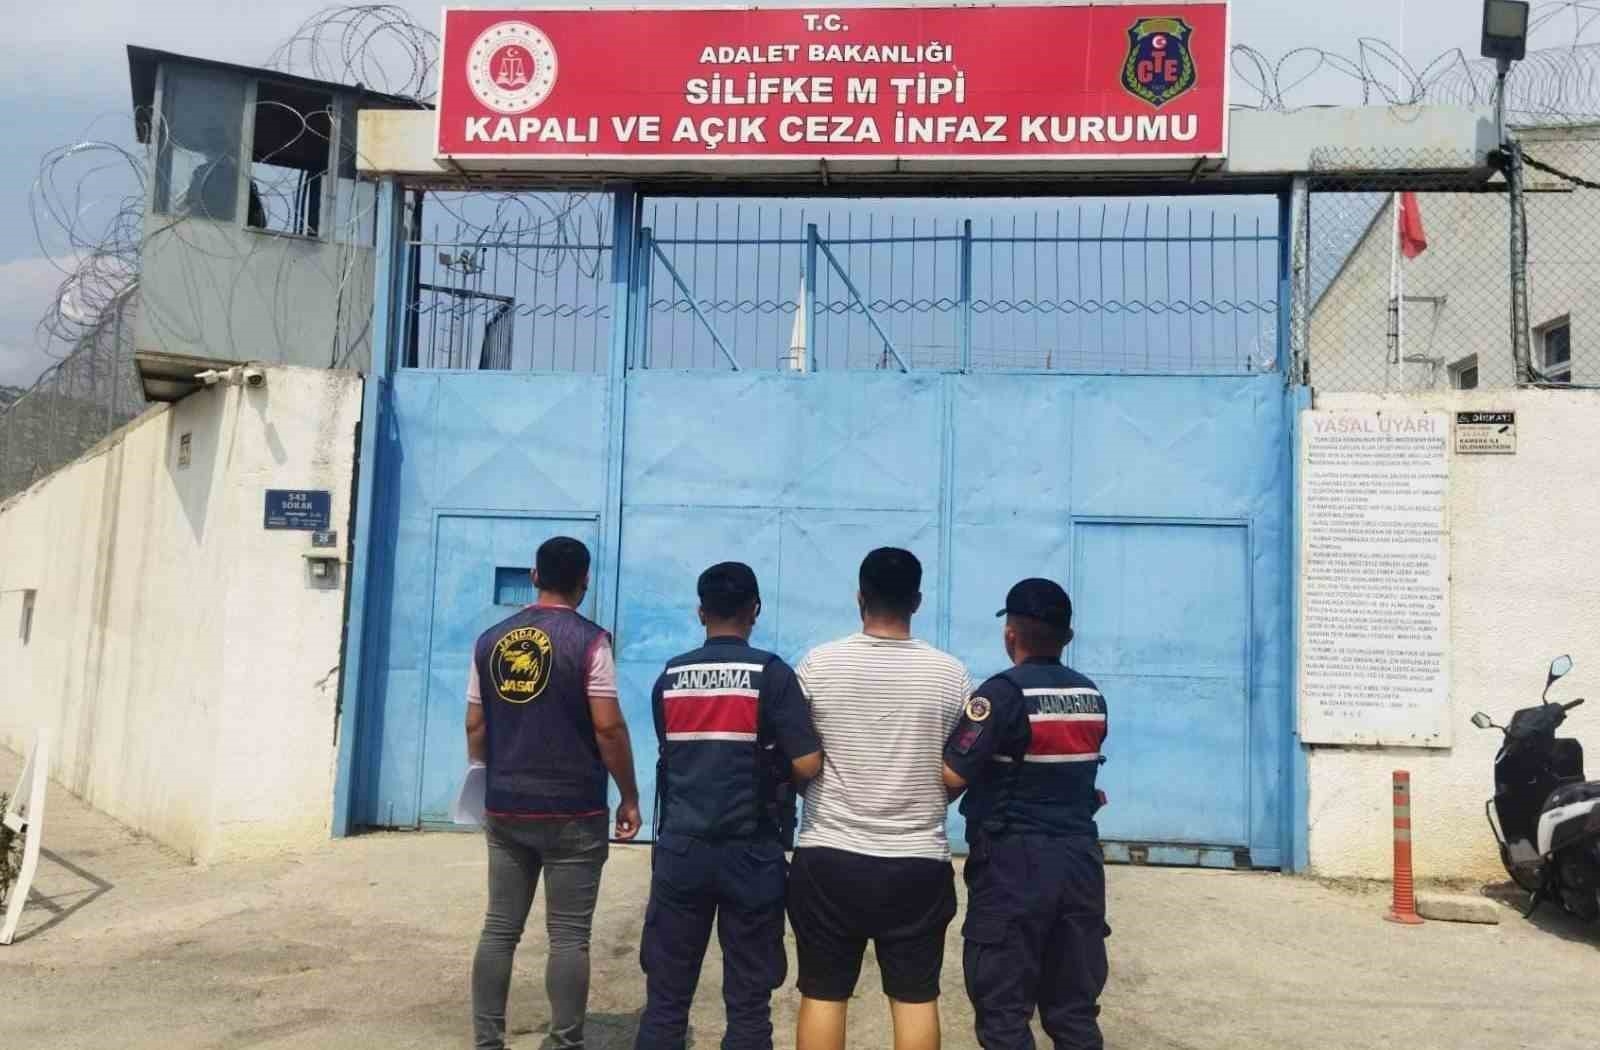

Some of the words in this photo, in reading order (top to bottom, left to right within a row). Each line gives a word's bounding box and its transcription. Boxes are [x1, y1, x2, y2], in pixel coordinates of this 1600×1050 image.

[804, 14, 849, 31] T.C.
[700, 45, 800, 63] ADALET
[808, 42, 953, 63] BAKANLIĞI
[685, 72, 833, 105] SİLİFKE
[847, 78, 877, 104] M
[890, 71, 966, 104] TİPİ
[464, 117, 599, 143] KAPALI
[611, 116, 661, 143] VE
[672, 117, 768, 150] AÇIK
[779, 116, 881, 143] CEZA
[895, 111, 1009, 143] İNFAZ
[1020, 115, 1198, 142] KURUMU
[1313, 418, 1374, 433] YASAL
[1379, 418, 1436, 433] UYARI
[499, 630, 550, 655] JANDARMA
[672, 670, 751, 689] JANDARMA
[1037, 695, 1099, 714] JANDARMA
